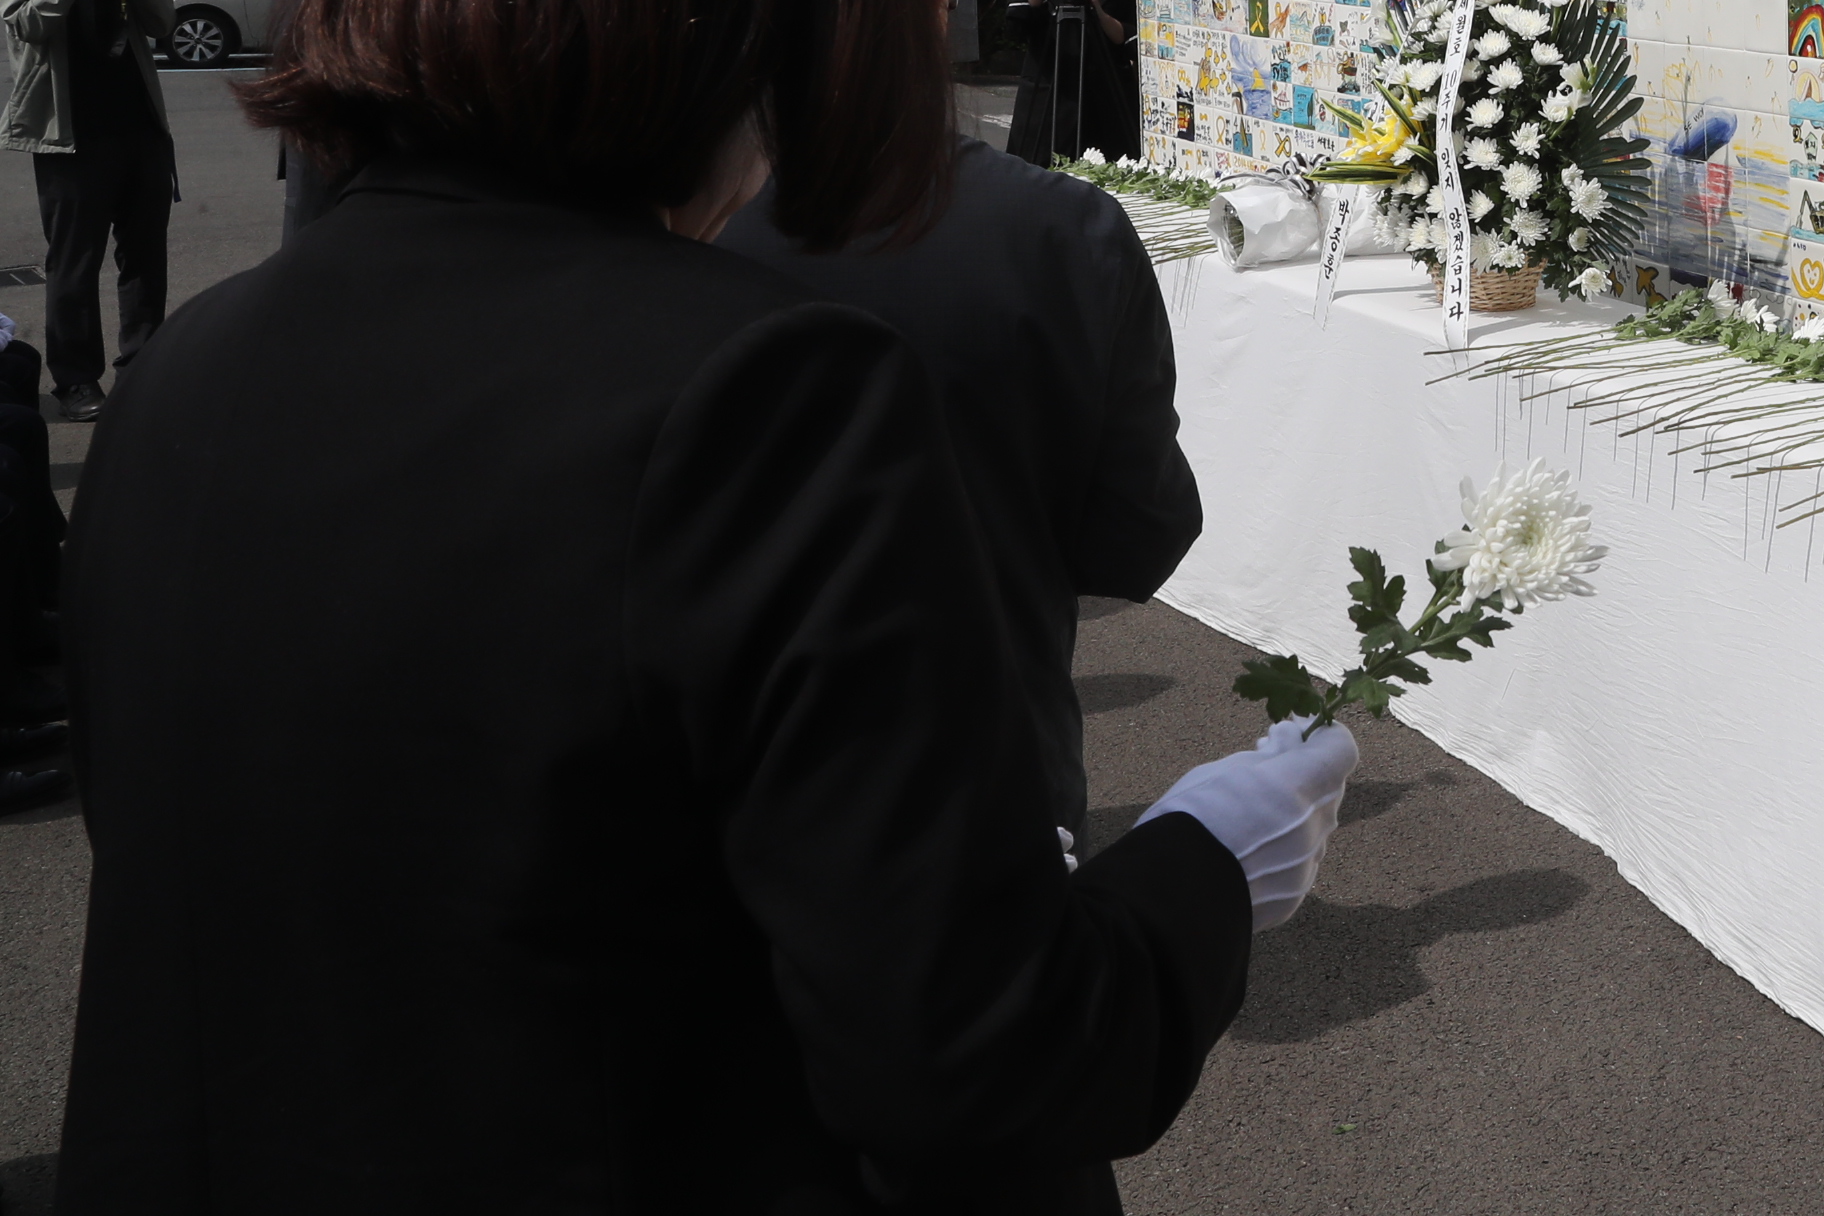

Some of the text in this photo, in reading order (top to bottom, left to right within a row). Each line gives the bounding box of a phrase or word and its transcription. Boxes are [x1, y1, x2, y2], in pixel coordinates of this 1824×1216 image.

[1439, 71, 1460, 134] 10주기
[1440, 151, 1456, 193] 잊지
[1448, 210, 1466, 322] 않겠습니다
